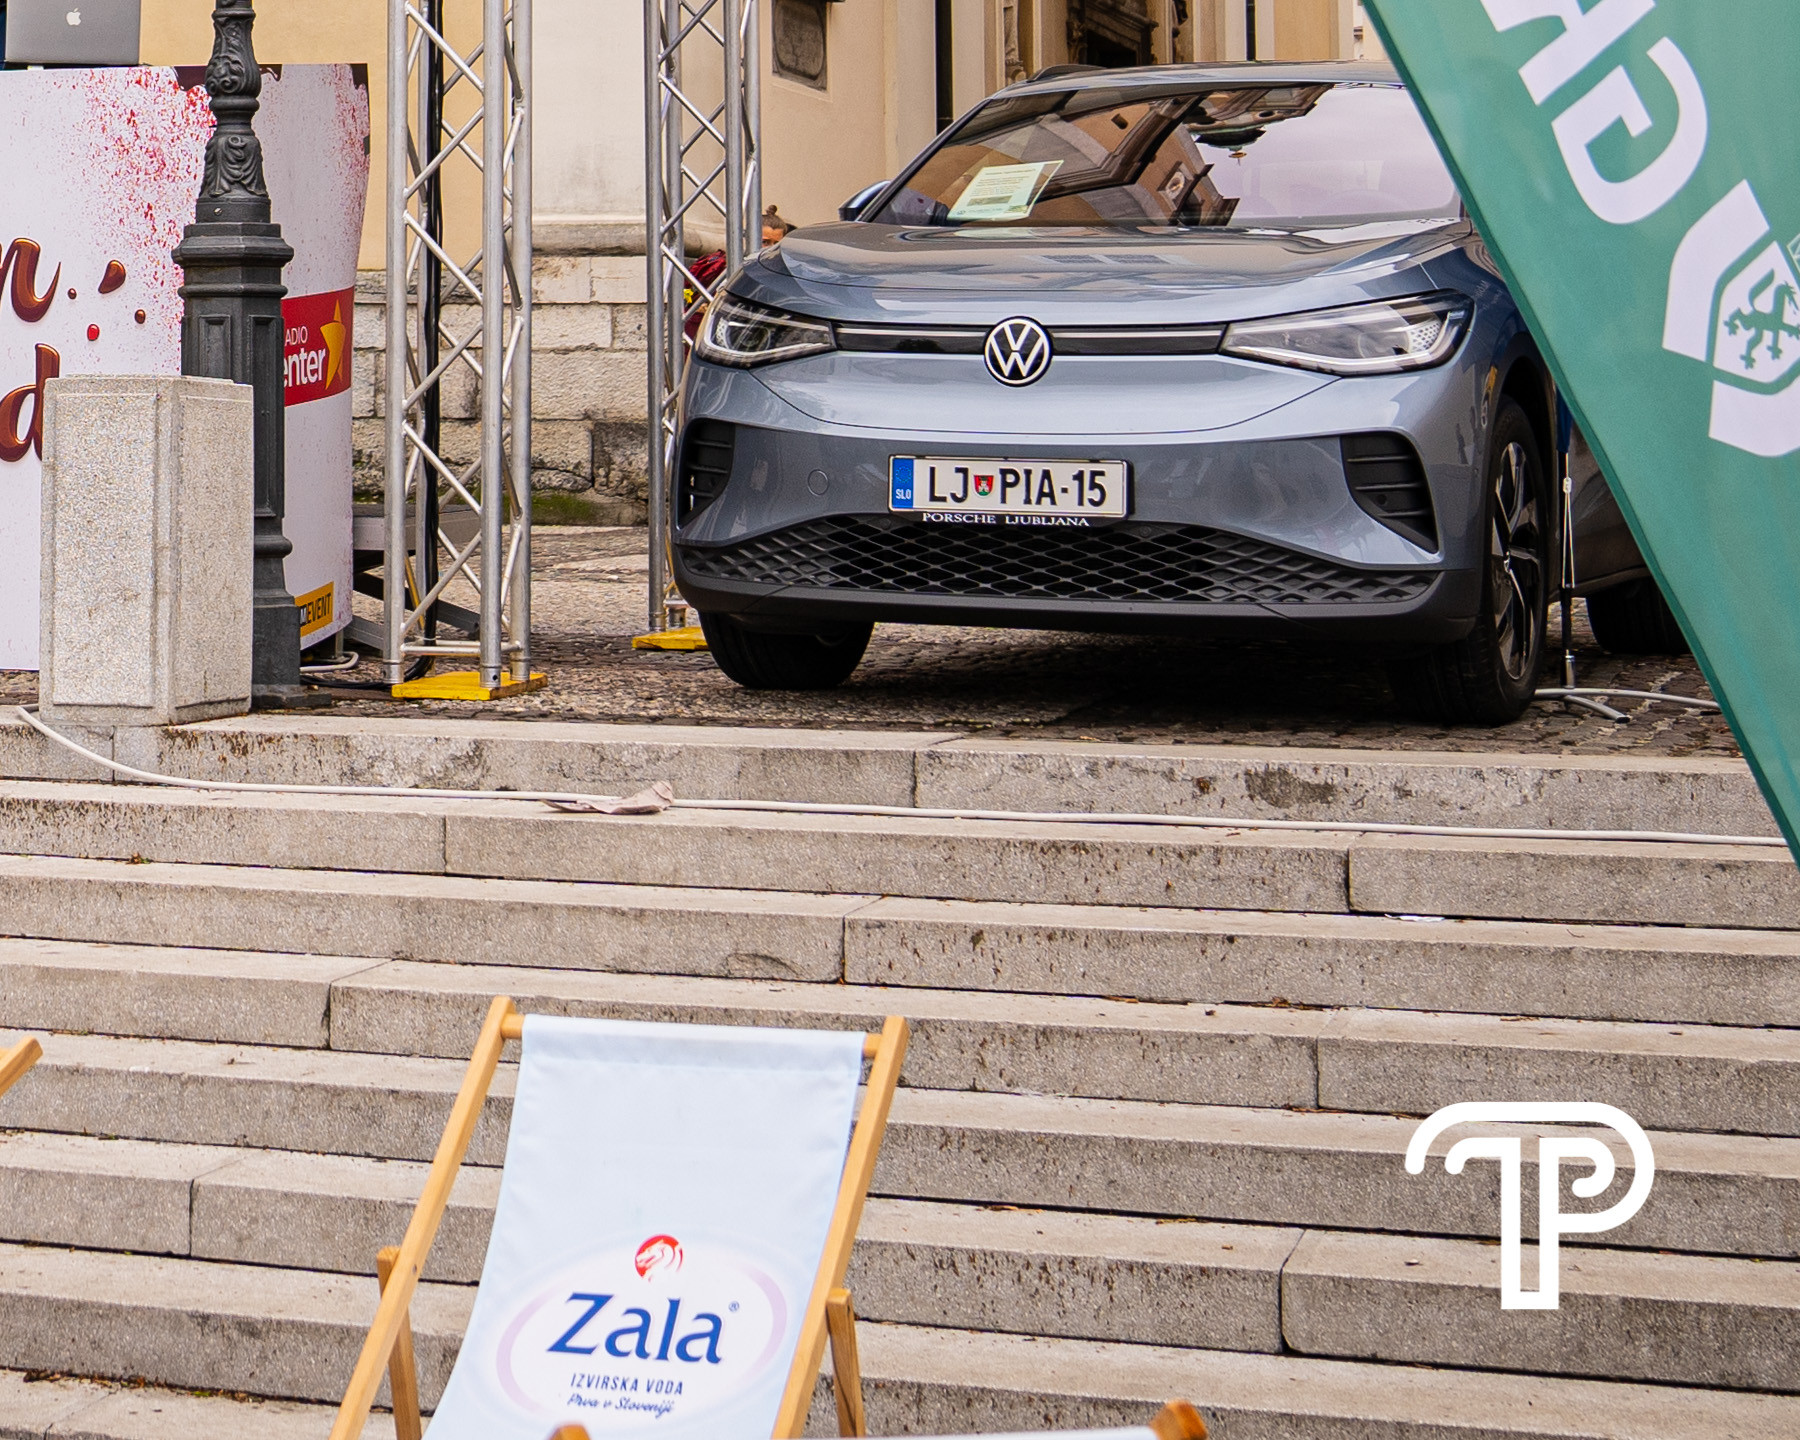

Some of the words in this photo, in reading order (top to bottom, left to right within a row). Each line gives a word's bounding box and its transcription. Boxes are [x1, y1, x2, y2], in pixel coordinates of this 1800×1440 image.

[284, 326, 308, 347] ADIO
[895, 489, 912, 500] SLO
[929, 466, 969, 503] LJ
[999, 467, 1107, 507] PIA-15
[922, 513, 997, 525] PORSCHE
[1005, 515, 1090, 527] LJUBLJANA
[546, 1292, 723, 1365] Zala
[570, 1373, 639, 1392] IZVIRSKA
[646, 1379, 683, 1395] VODA
[567, 1393, 598, 1408] Prva
[615, 1396, 674, 1419] Sloveniji
